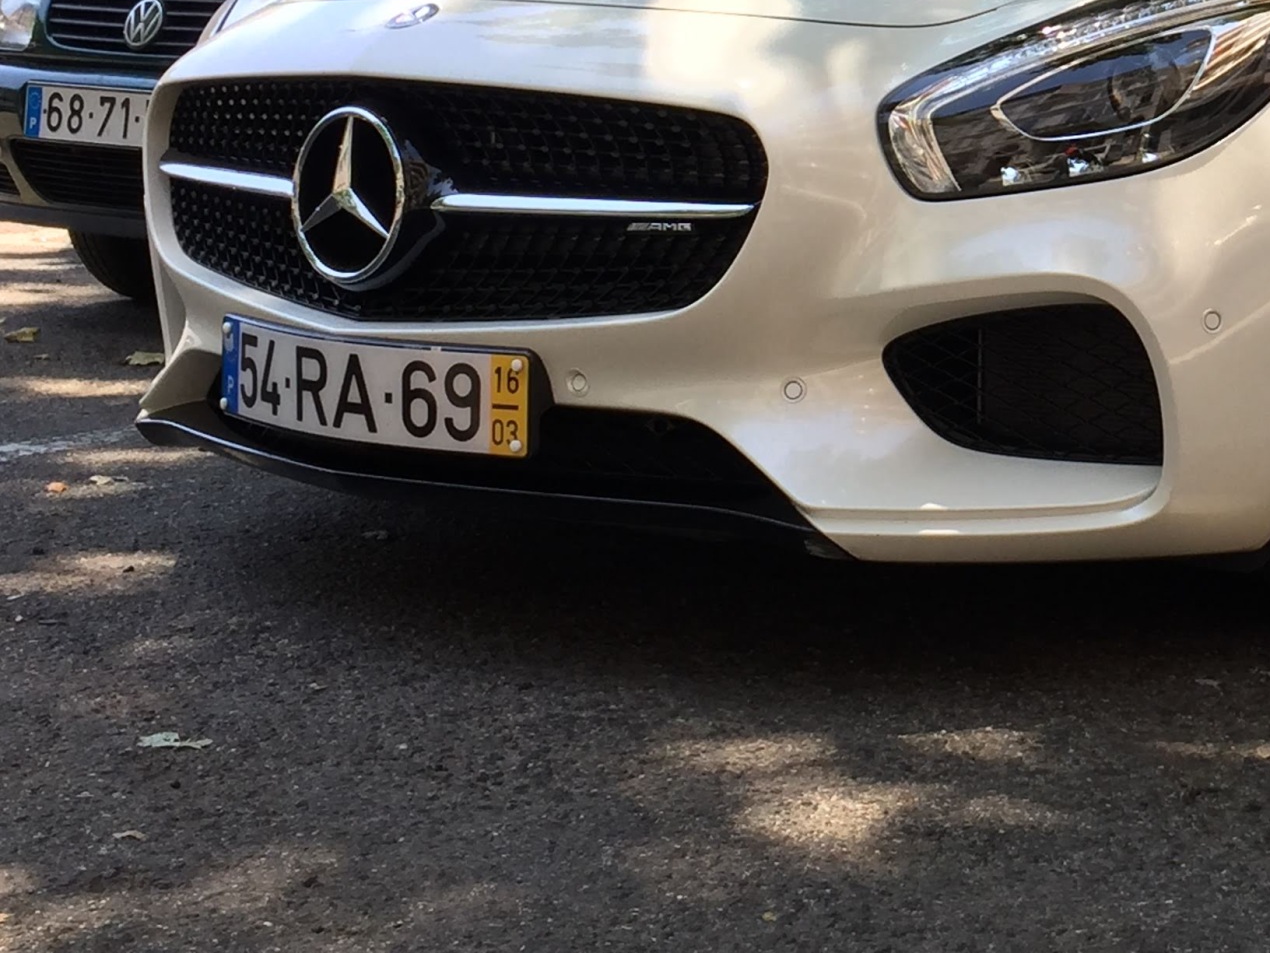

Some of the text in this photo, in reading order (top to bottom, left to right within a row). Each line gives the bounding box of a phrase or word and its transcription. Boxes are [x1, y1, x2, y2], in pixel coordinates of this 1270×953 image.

[29, 116, 37, 129] P
[647, 222, 692, 231] AMG
[494, 365, 520, 394] 16
[491, 419, 520, 447] 03
